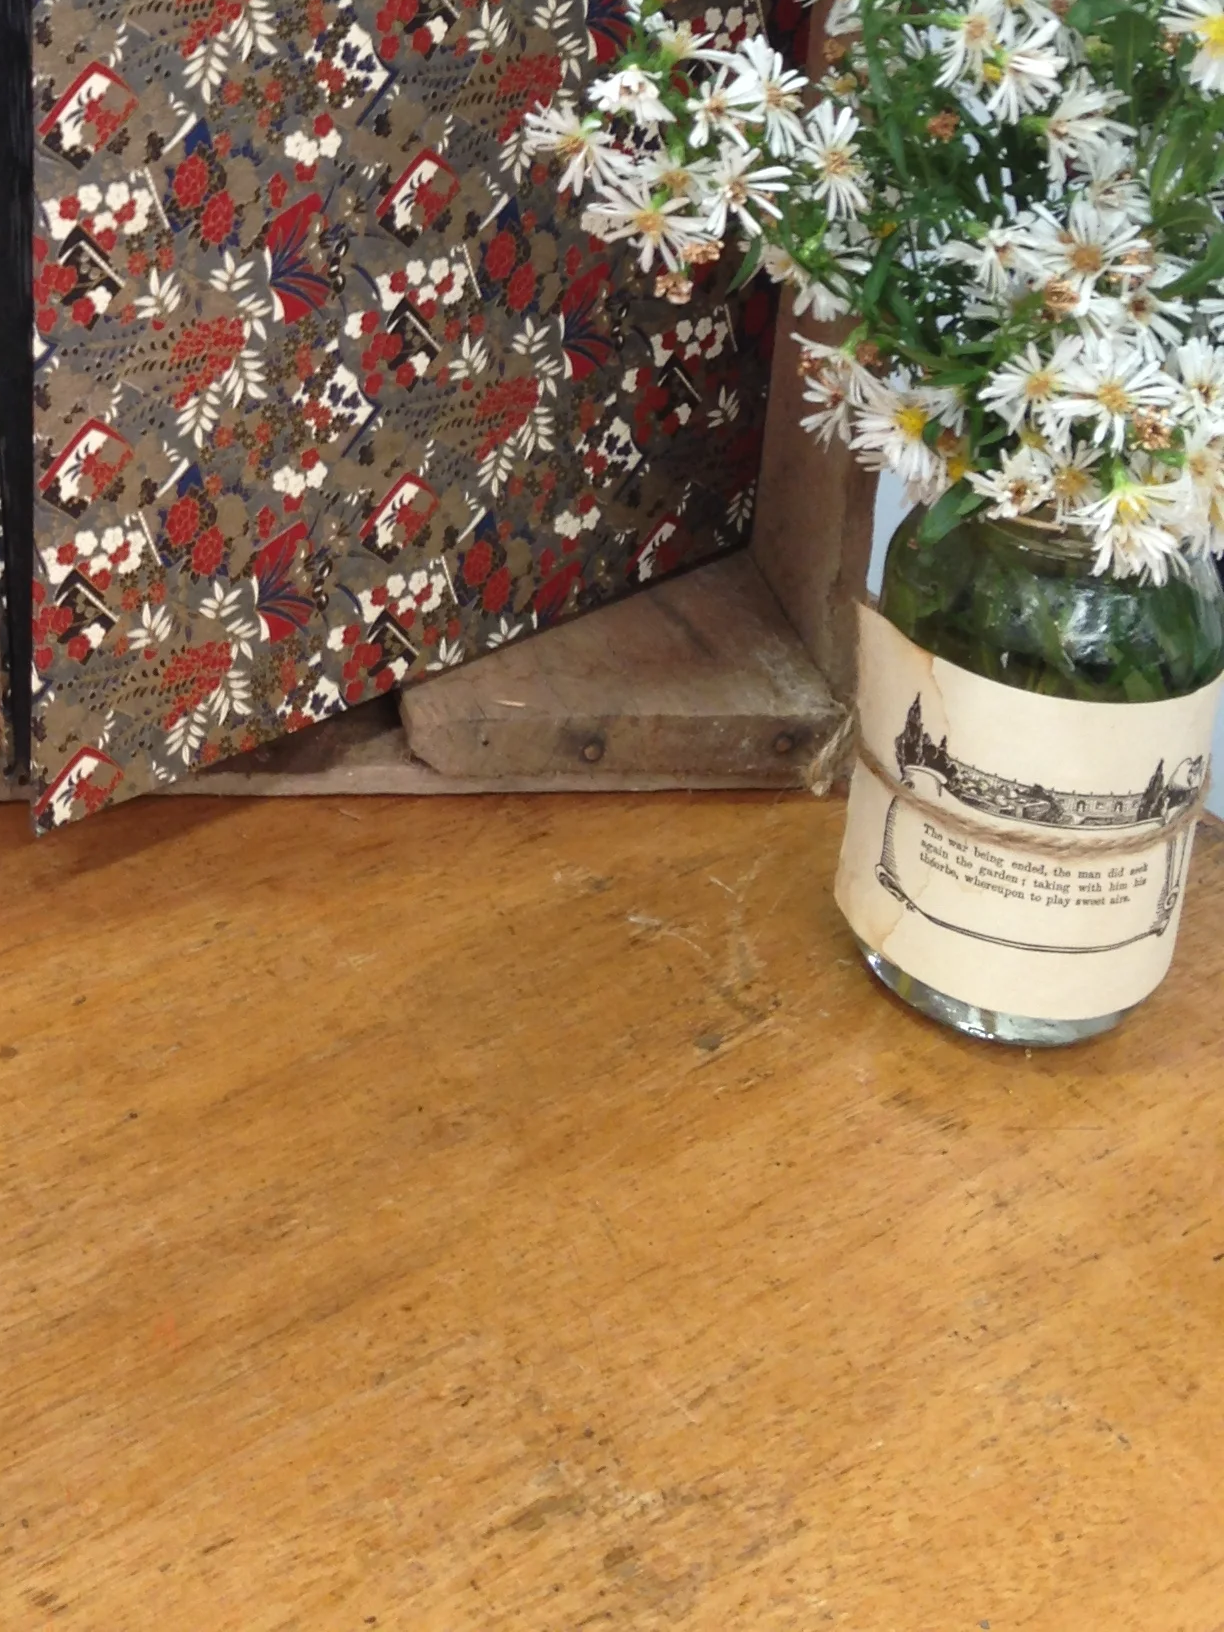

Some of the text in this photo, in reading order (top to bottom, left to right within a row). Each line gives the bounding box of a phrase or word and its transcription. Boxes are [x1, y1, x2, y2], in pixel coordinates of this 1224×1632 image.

[920, 838, 949, 861] again
[955, 855, 974, 870] the
[1033, 879, 1071, 894] taking
[1078, 882, 1103, 893] with
[1108, 881, 1128, 893] him
[1133, 876, 1148, 888] his
[923, 822, 944, 842] The
[948, 837, 969, 853] war
[974, 846, 1005, 868] being
[1011, 859, 1048, 878] ended,
[1053, 867, 1072, 879] the
[1078, 870, 1102, 880] man
[1107, 867, 1125, 879] did
[964, 874, 1025, 900] whereupon
[1030, 892, 1042, 903] to
[1046, 894, 1071, 908] play
[1075, 897, 1106, 906] sweet
[1109, 894, 1131, 905] airs.
